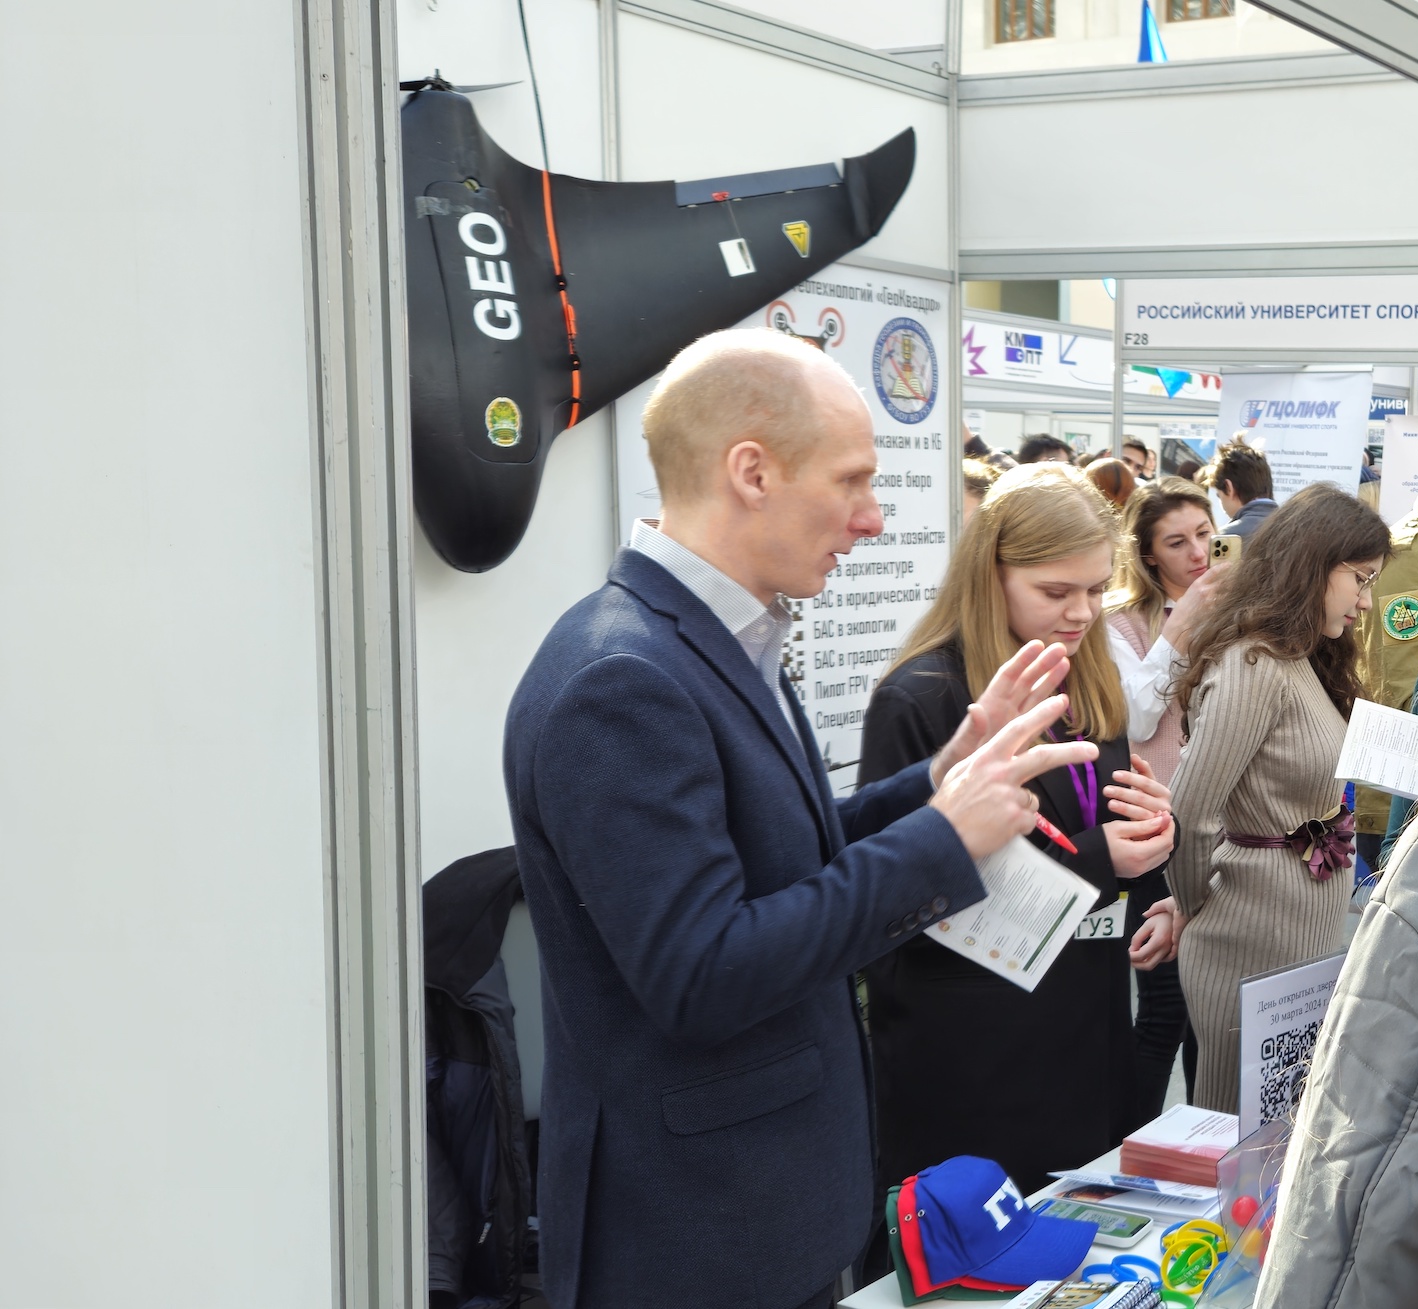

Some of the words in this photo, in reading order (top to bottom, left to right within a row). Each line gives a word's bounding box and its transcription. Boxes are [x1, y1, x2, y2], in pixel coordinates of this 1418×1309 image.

[458, 211, 522, 340] GEO
[1137, 302, 1246, 319] РОССИЙСКИЙ
[1250, 304, 1371, 320] УНИВЕРСИТЕТ
[1124, 333, 1149, 346] F28
[1265, 400, 1341, 420] ГЦОЛИФК
[914, 436, 921, 449] и
[923, 437, 930, 450] в
[906, 470, 932, 492] бюро
[836, 564, 843, 577] в
[845, 560, 914, 581] архитектуре
[813, 590, 834, 609] БАС
[837, 593, 843, 607] в
[846, 583, 921, 611] юридической
[814, 620, 835, 640] БАС
[838, 623, 844, 637] в
[847, 619, 897, 636] экологии
[814, 650, 835, 670] БАС
[839, 652, 845, 666] в
[815, 681, 846, 700] Пилот
[849, 675, 869, 694] FPV
[1257, 1000, 1277, 1014] День
[1278, 986, 1315, 1004] открытых
[1270, 1013, 1280, 1025] 30
[1281, 1007, 1303, 1021] марта
[1304, 997, 1321, 1014] 2024
